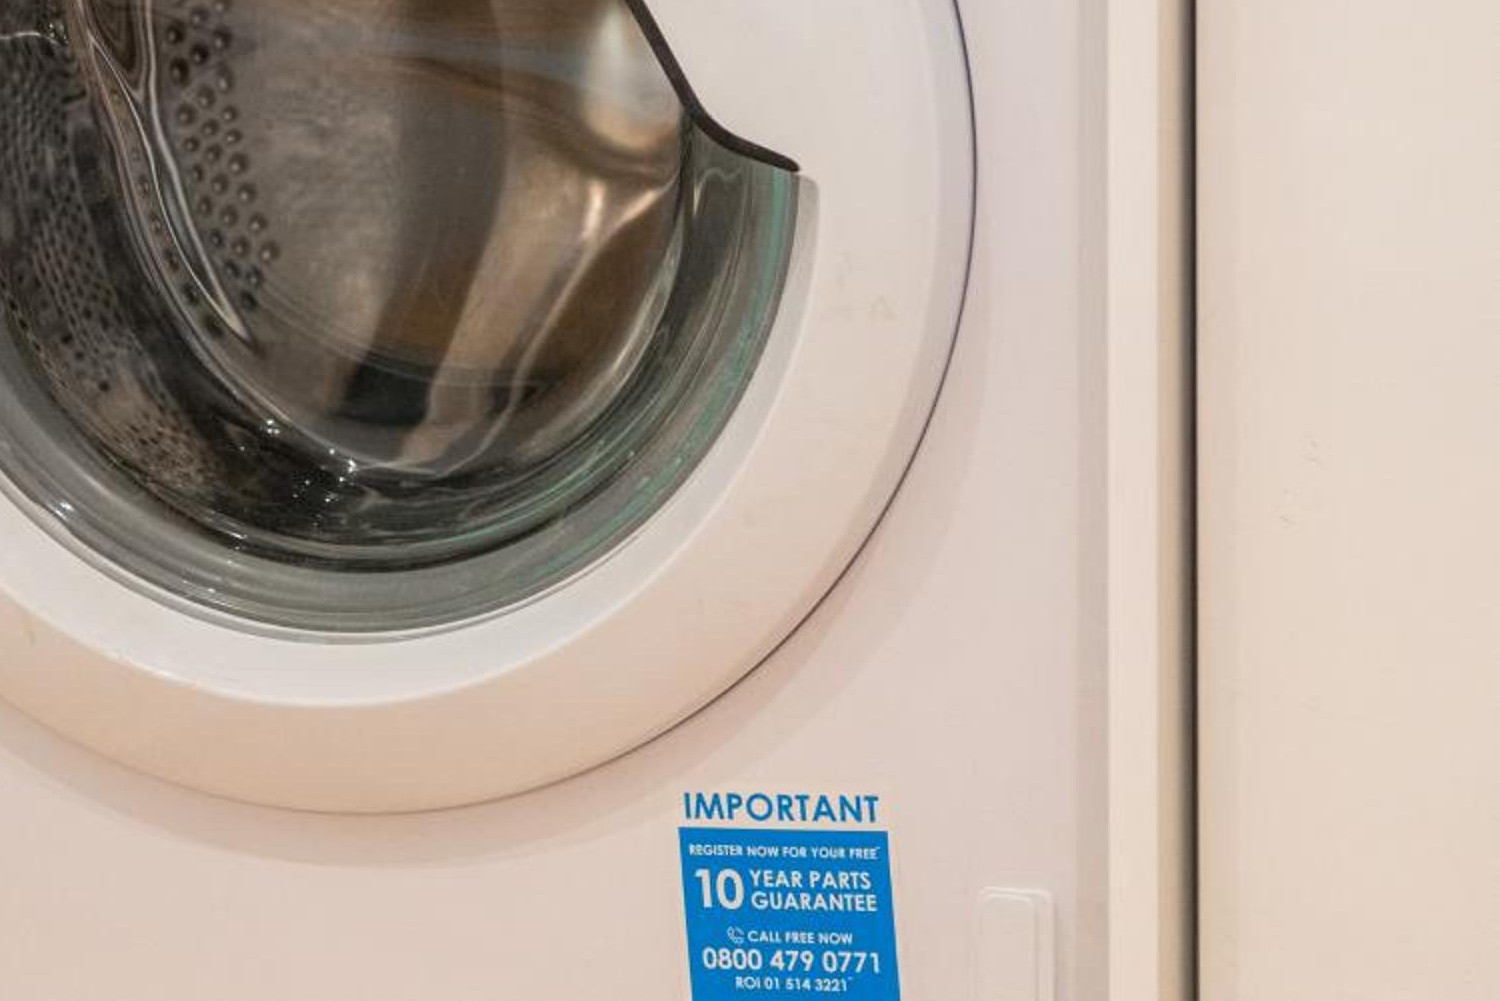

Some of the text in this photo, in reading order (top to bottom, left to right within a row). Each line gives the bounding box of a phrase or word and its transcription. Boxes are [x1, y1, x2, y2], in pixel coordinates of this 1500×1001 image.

[683, 791, 879, 823] IMPORTANT
[688, 843, 743, 856] REGISTER
[747, 845, 779, 858] NOW
[782, 846, 807, 858] FOR
[811, 847, 845, 859] YOUR
[694, 868, 744, 910] 10
[750, 870, 871, 890] YEAR PARTS
[751, 891, 878, 912] GUARANTEE
[747, 930, 853, 945] CALL FREE NOW
[703, 947, 881, 974] 0800 479 0771
[735, 976, 761, 990] ROI
[764, 977, 780, 990] 01
[785, 977, 811, 991] 514
